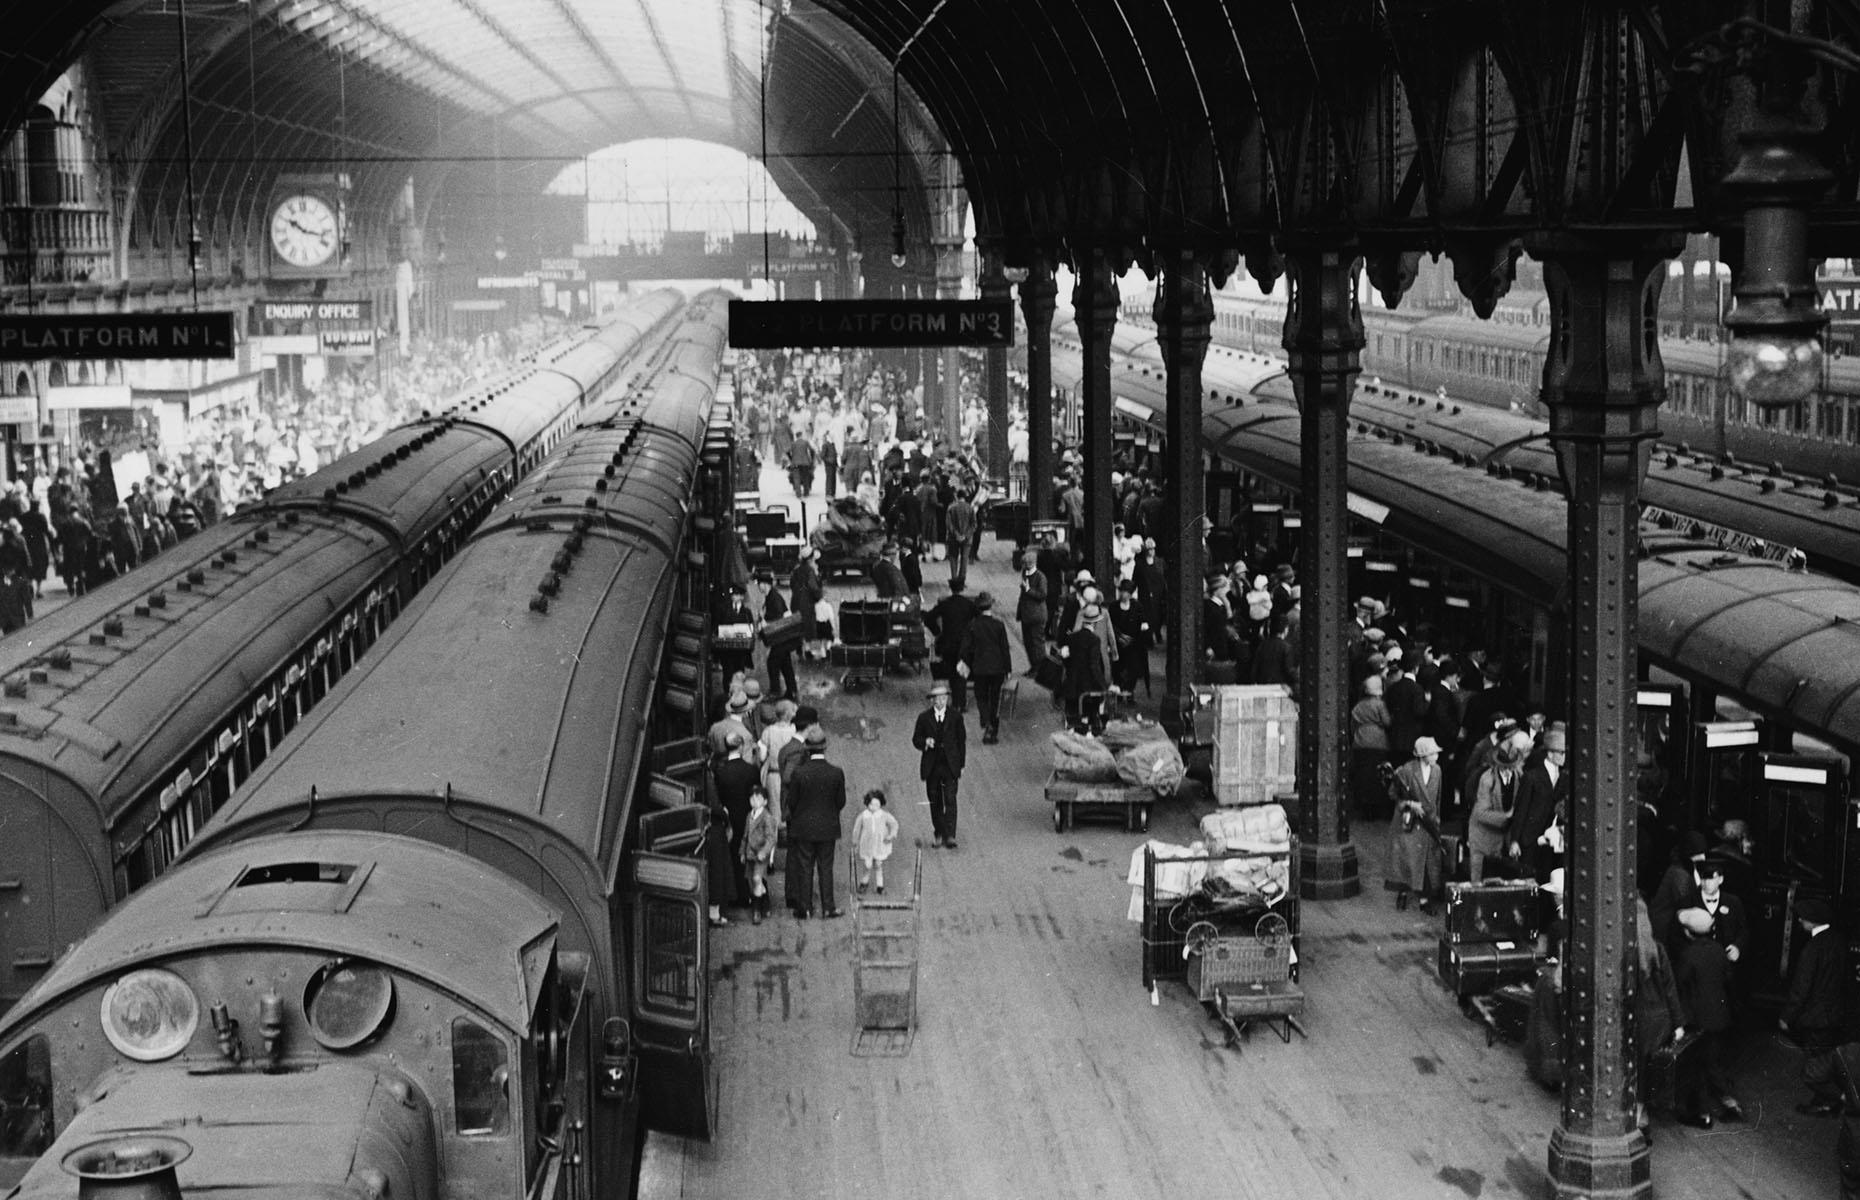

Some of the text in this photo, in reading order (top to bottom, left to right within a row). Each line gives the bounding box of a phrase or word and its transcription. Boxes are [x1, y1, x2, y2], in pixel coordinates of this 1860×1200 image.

[265, 303, 360, 319] ENQUIRY OFFICE
[800, 312, 946, 333] PLATFORM
[1, 327, 158, 348] PLATFORM
